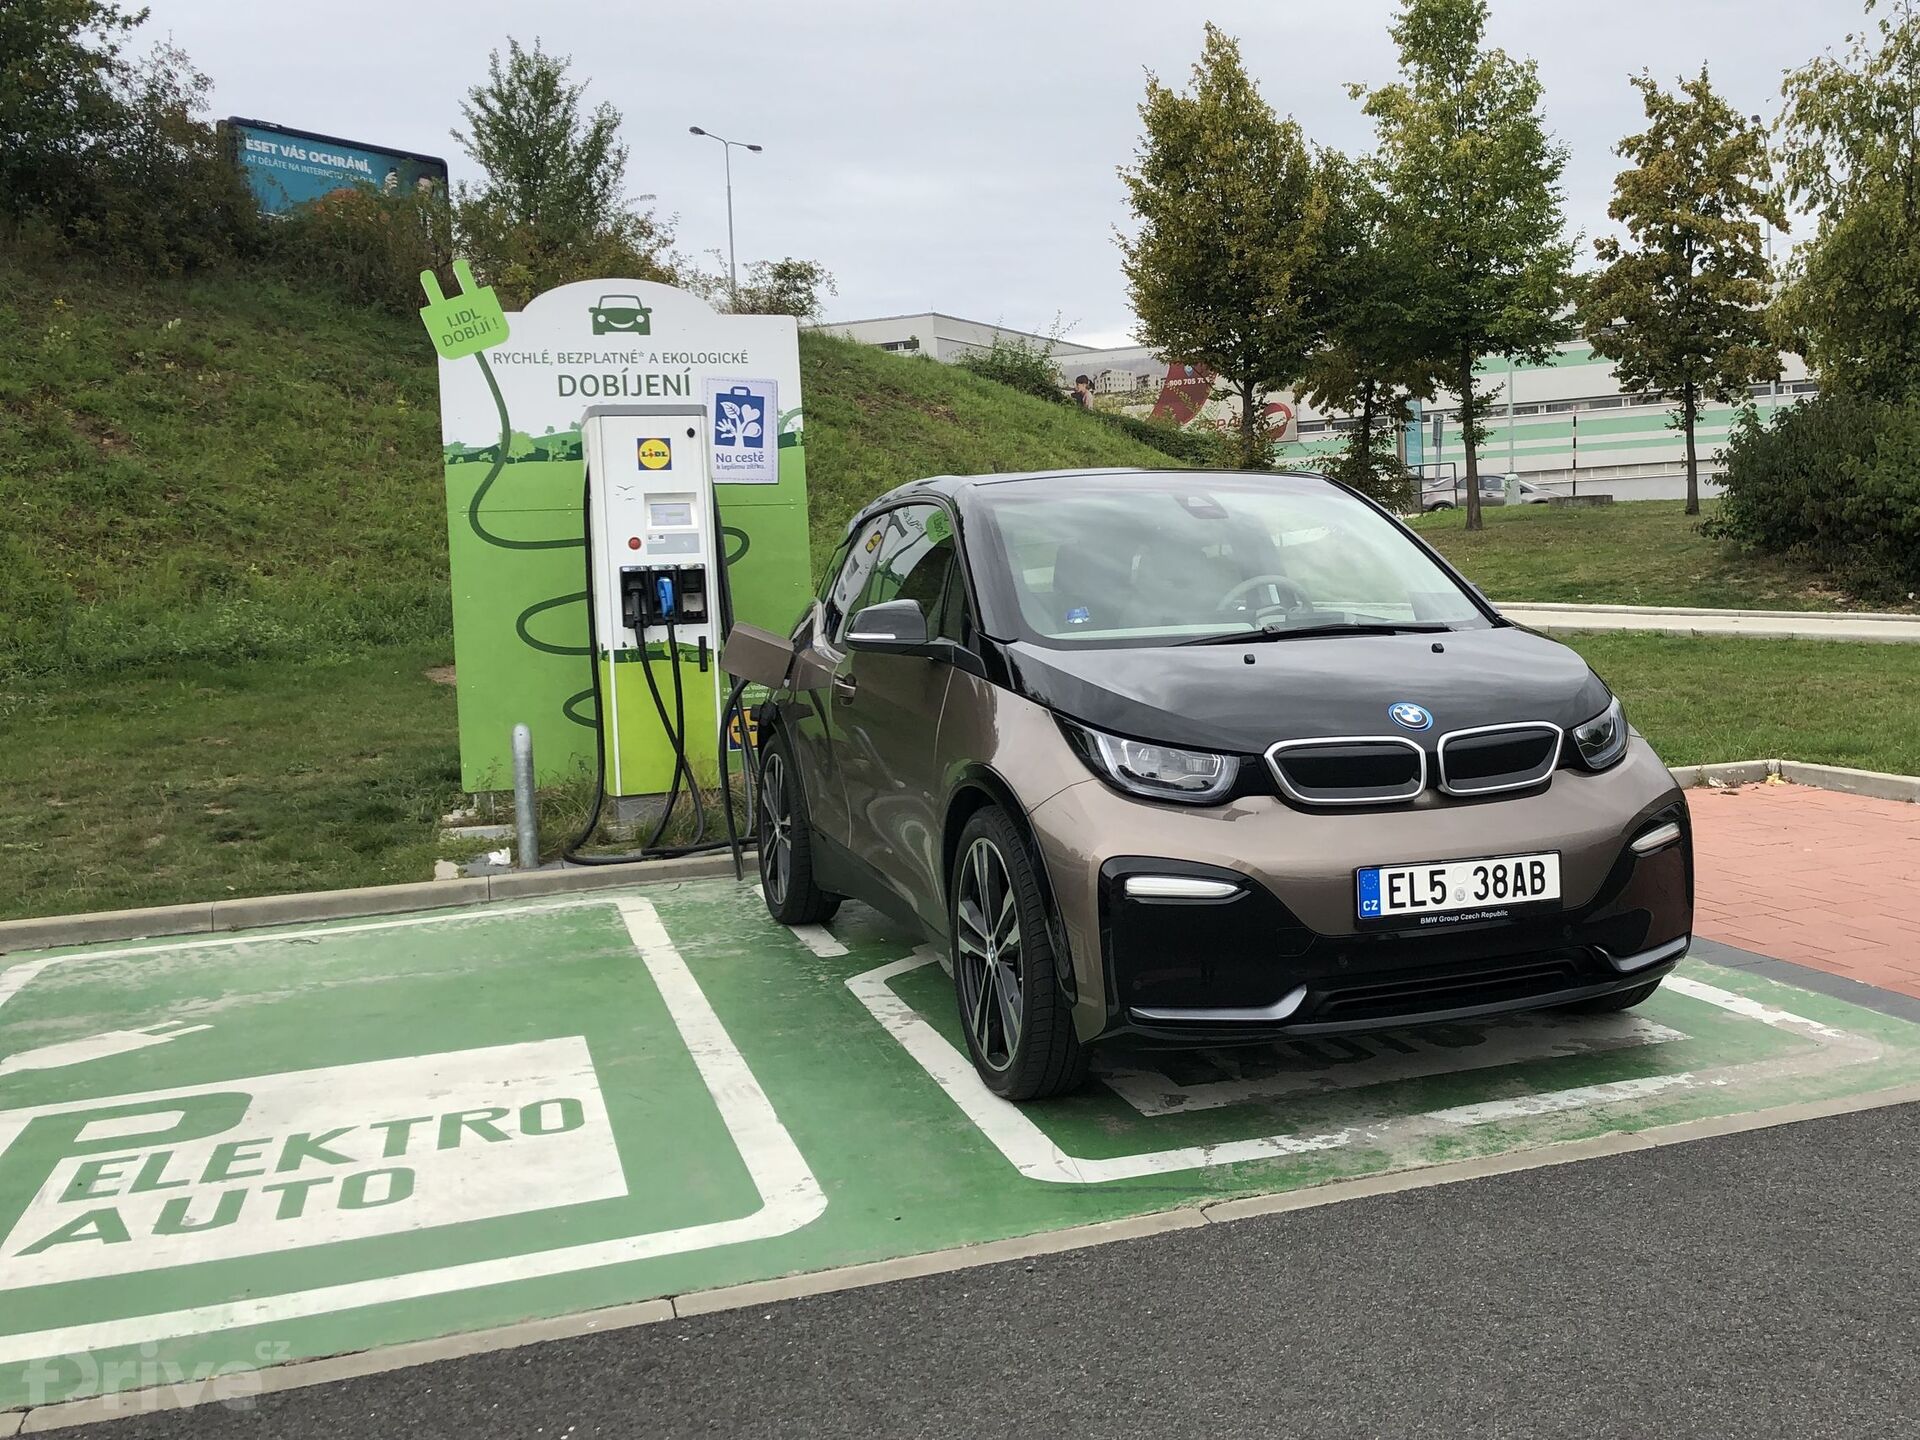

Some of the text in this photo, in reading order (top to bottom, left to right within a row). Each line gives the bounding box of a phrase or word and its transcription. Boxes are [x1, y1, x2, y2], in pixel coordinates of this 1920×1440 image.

[245, 138, 278, 155] ESET
[280, 144, 307, 160] VÁS
[446, 308, 482, 328] LIDL
[493, 349, 553, 366] RYCHLÉ,
[648, 352, 659, 364] A
[662, 349, 749, 364] EKOLOGICKÉ
[557, 367, 691, 398] DOBÍJENÍ
[715, 451, 765, 463] Na cestě
[1472, 860, 1547, 901] 38AB
[1363, 899, 1378, 911] CZ
[1420, 909, 1508, 925] BMW Group Czech Republic
[58, 1098, 585, 1204] ELEKTRO
[12, 1167, 415, 1257] AUTO
